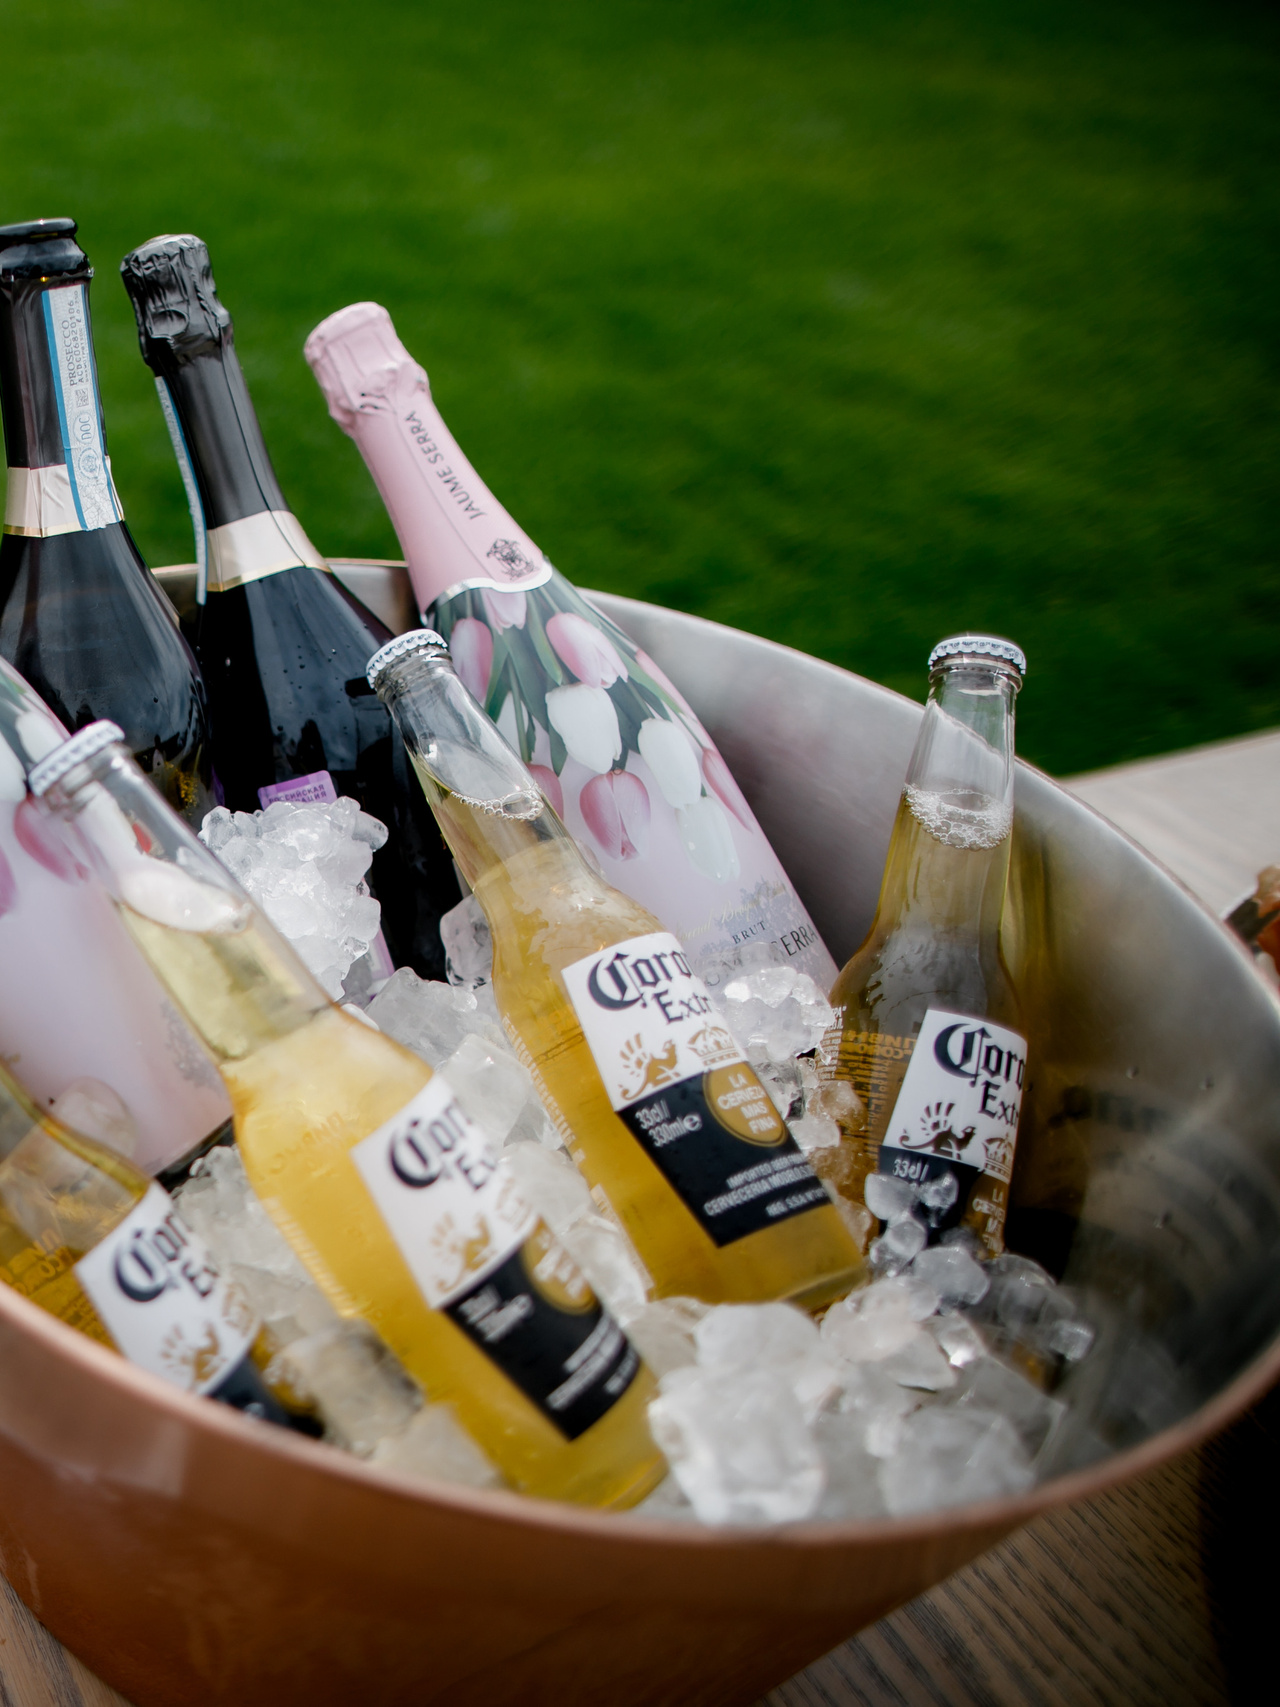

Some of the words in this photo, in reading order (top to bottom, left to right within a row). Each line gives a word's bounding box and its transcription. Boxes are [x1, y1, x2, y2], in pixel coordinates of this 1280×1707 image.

[61, 319, 78, 387] PROSECCO
[79, 416, 92, 440] DOC
[404, 410, 444, 464] SERRA
[436, 467, 487, 520] JAUME
[732, 920, 766, 945] BRUT
[771, 924, 819, 957] ERRA
[728, 1073, 748, 1088] LA
[748, 1116, 777, 1134] FINA
[726, 1162, 773, 1189] IMPORTED
[704, 1179, 772, 1217] CERVECERIA
